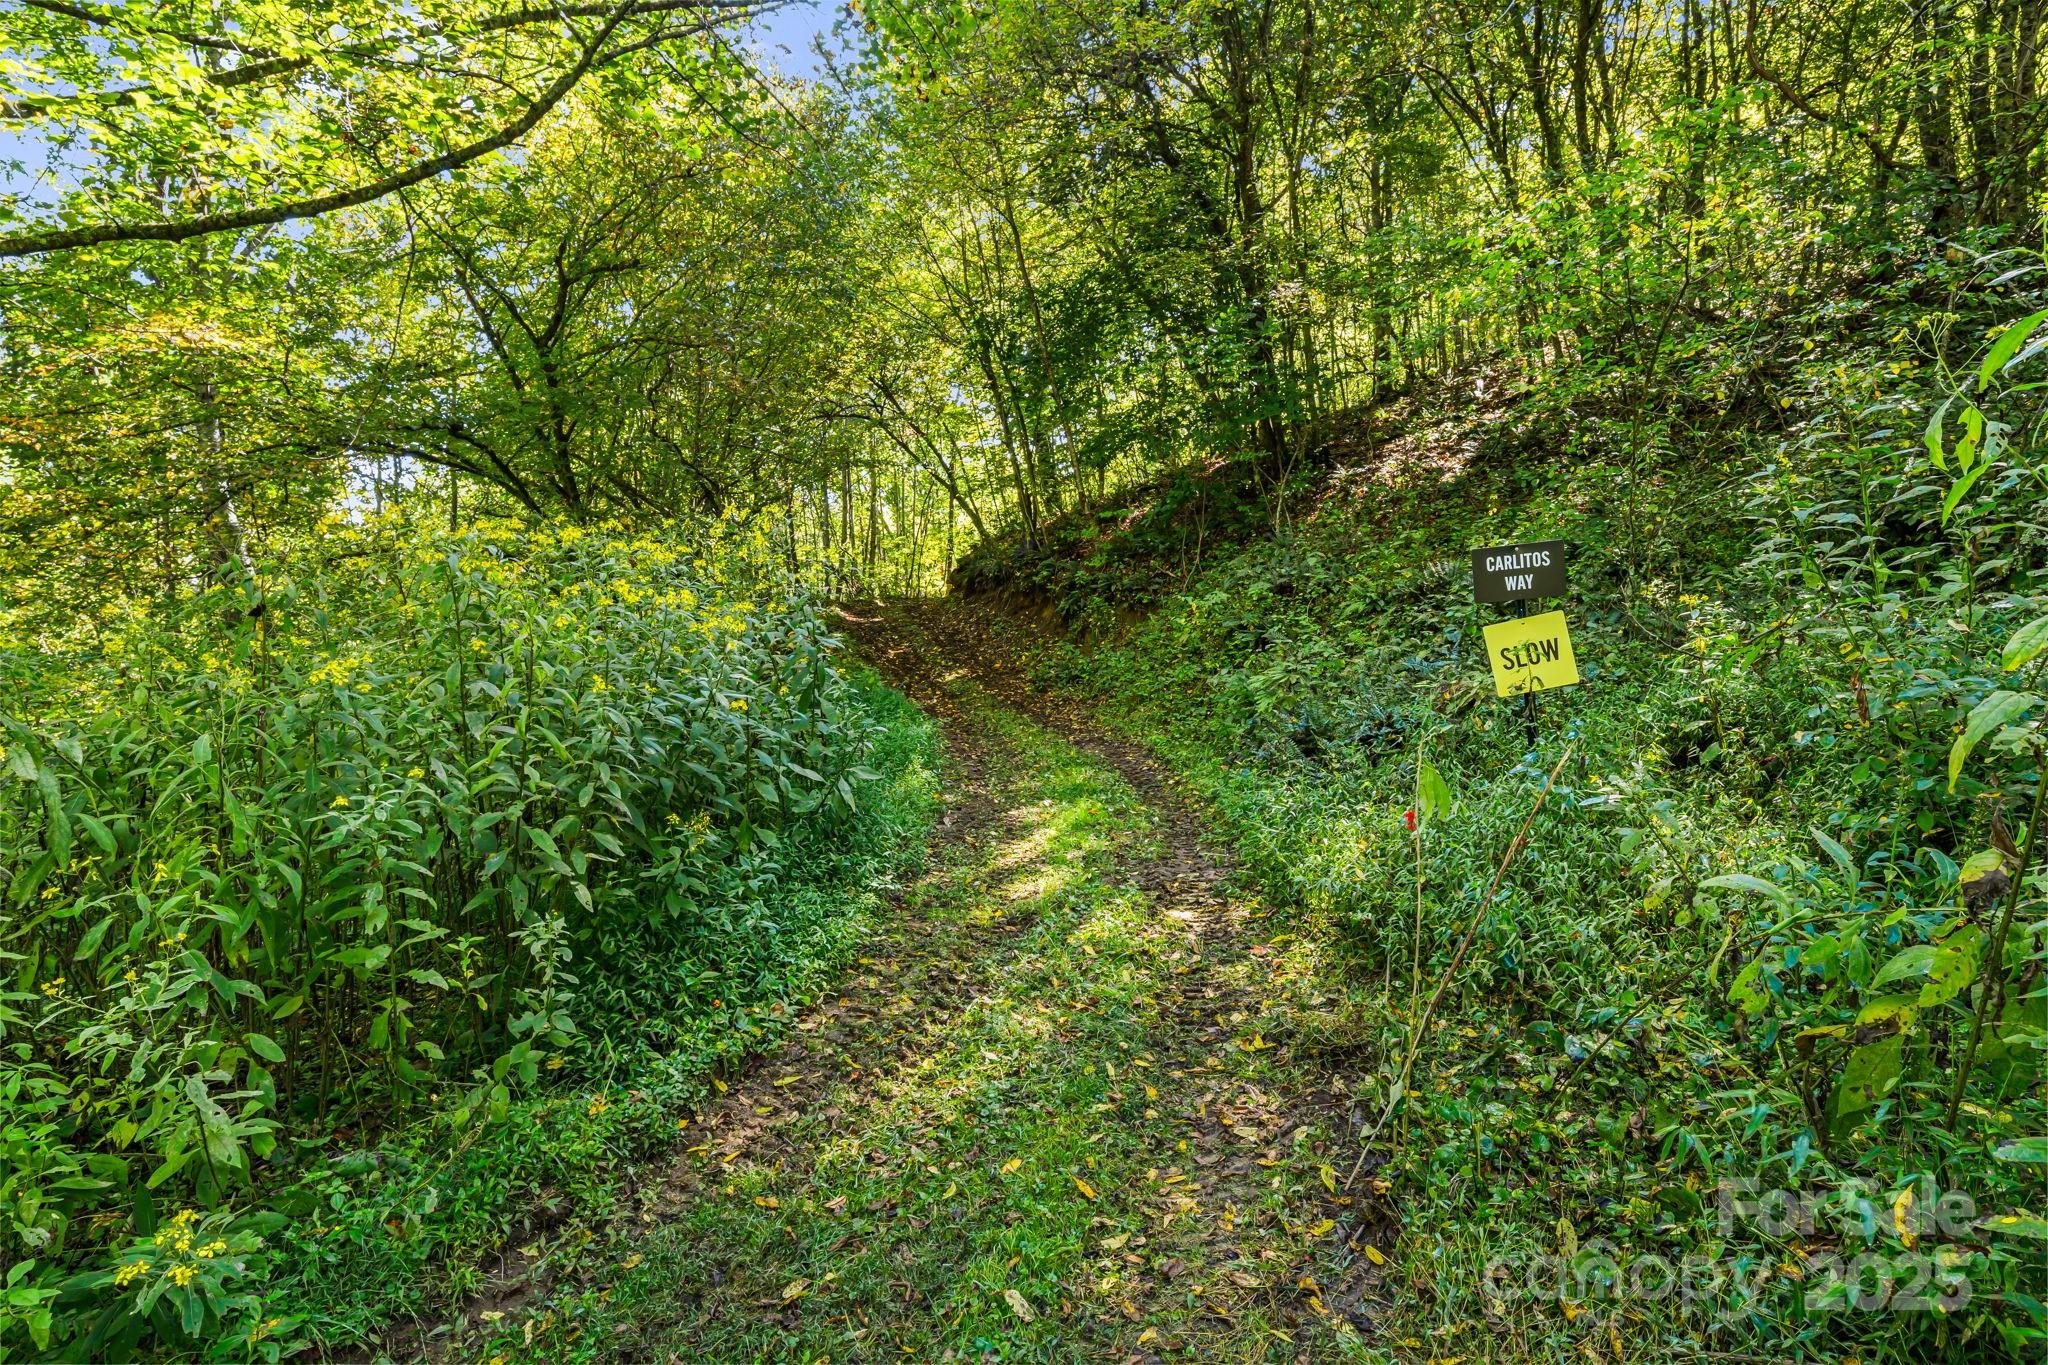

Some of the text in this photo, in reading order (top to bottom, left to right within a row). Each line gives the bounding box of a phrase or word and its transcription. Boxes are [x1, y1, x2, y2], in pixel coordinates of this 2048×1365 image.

[1486, 551, 1550, 572] CARLITOS
[1505, 574, 1534, 591] WAY
[1500, 638, 1559, 670] SLOW
